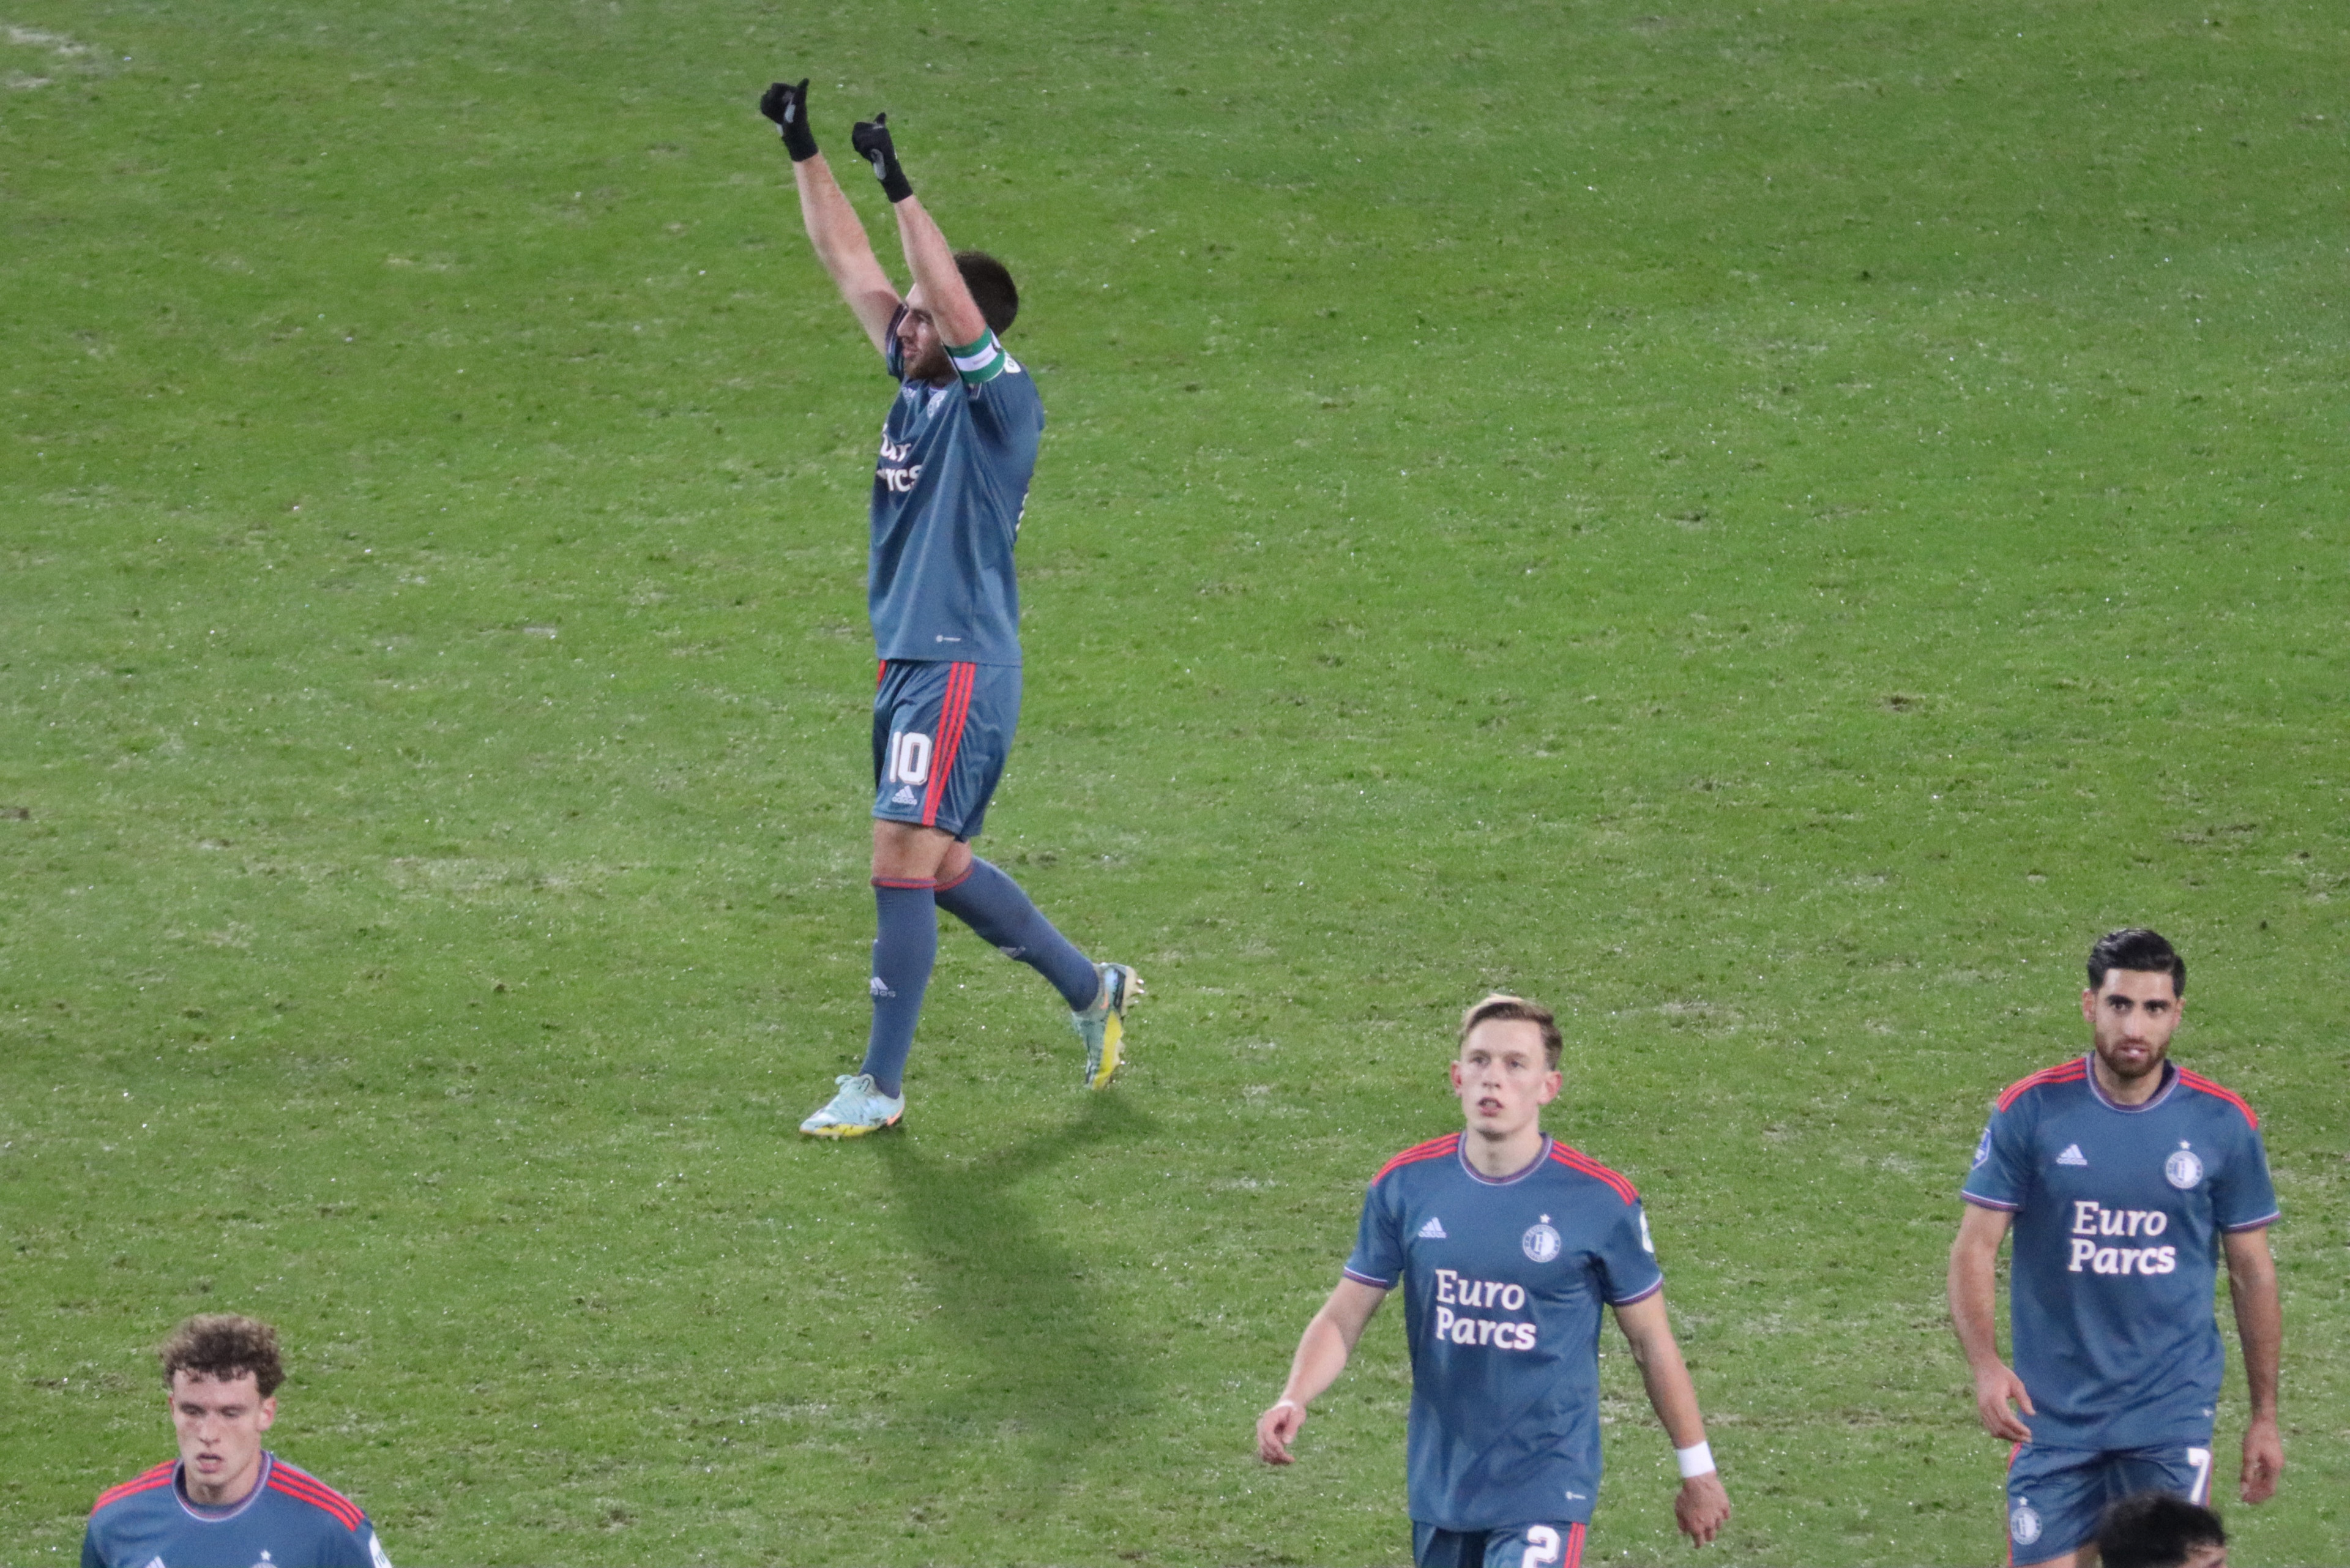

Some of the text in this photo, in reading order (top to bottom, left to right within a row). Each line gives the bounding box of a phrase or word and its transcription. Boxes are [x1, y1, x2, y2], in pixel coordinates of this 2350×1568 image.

[889, 731, 932, 785] 10
[2073, 1201, 2167, 1236] Euro
[2069, 1239, 2176, 1274] Parcs
[1436, 1270, 1524, 1310] Euro
[1436, 1307, 1536, 1350] Parcs
[2188, 1447, 2210, 1505] 7
[1521, 1525, 1560, 1568] 2
